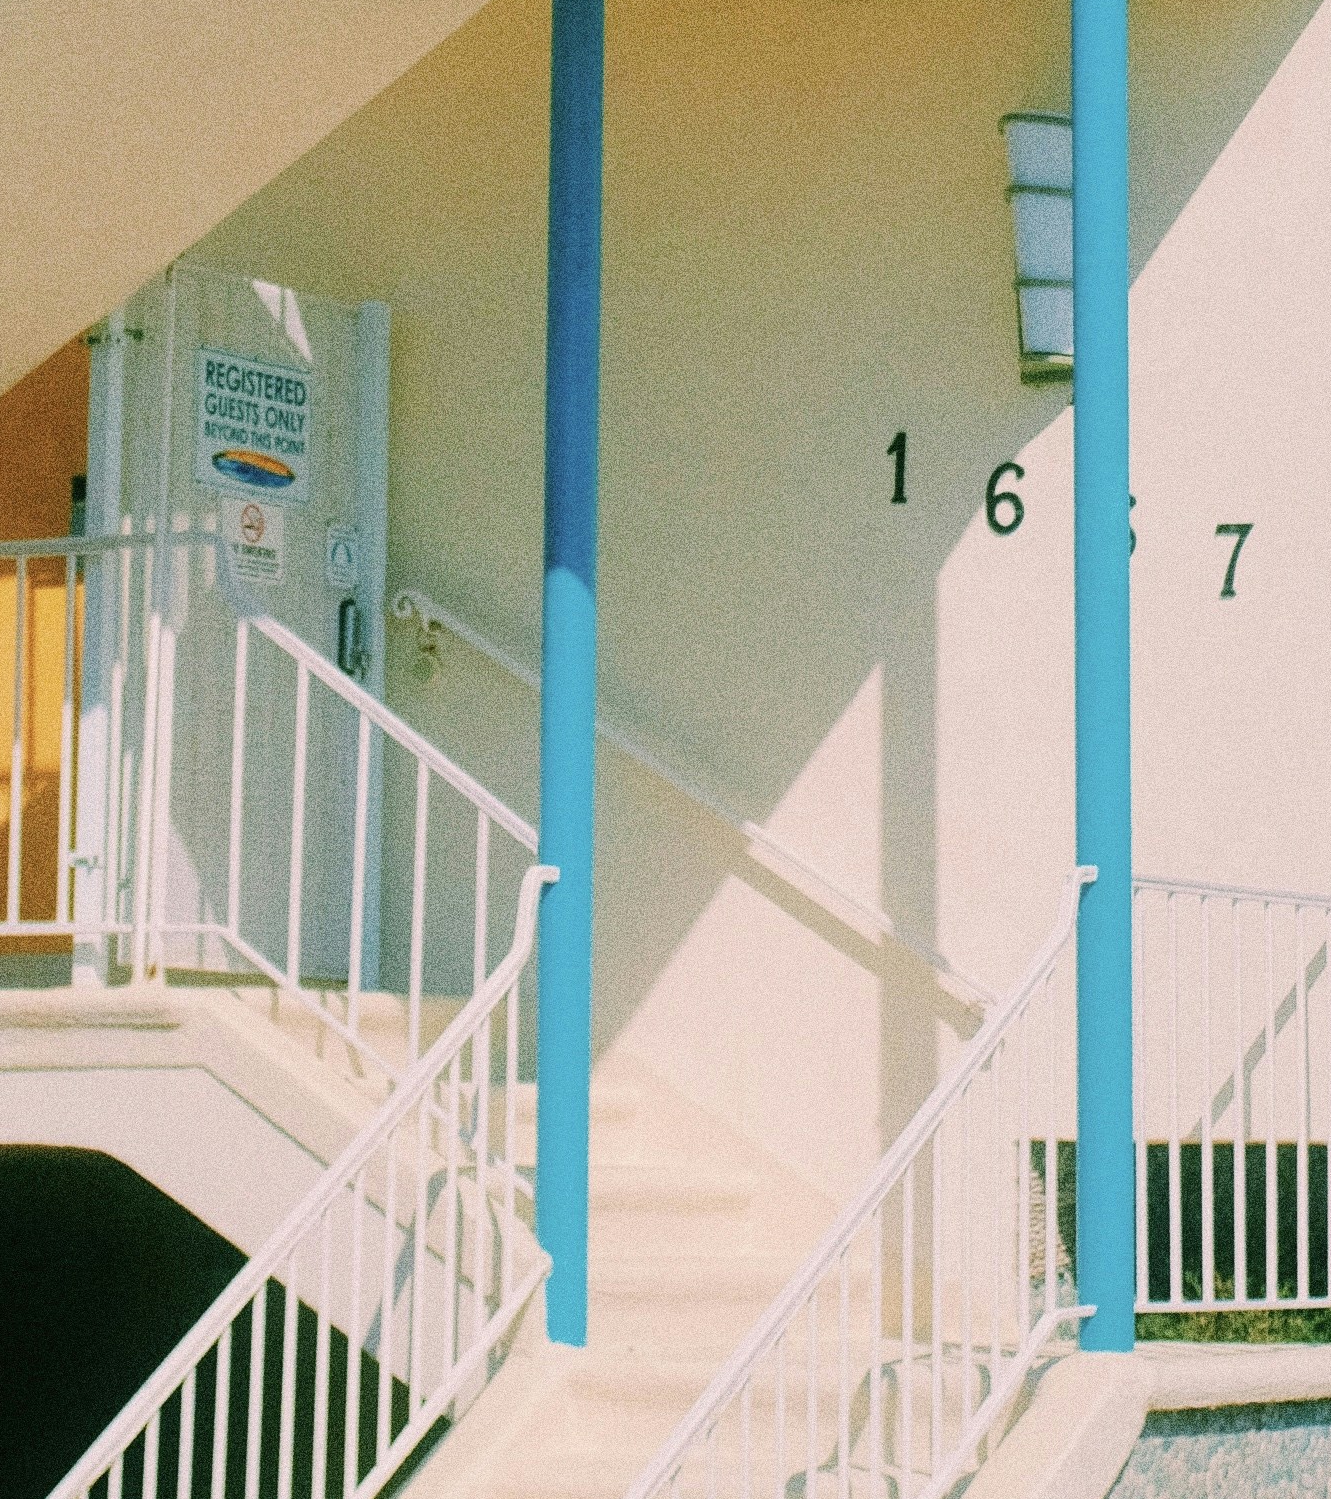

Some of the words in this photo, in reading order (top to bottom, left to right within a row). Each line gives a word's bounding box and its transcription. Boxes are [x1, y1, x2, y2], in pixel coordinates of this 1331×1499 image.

[204, 360, 308, 407] REGISTERED
[204, 393, 261, 427] GUESTS
[264, 406, 307, 434] ONLY
[203, 421, 249, 445] BEYOND
[250, 431, 272, 451] THIS
[885, 429, 1256, 601] 167
